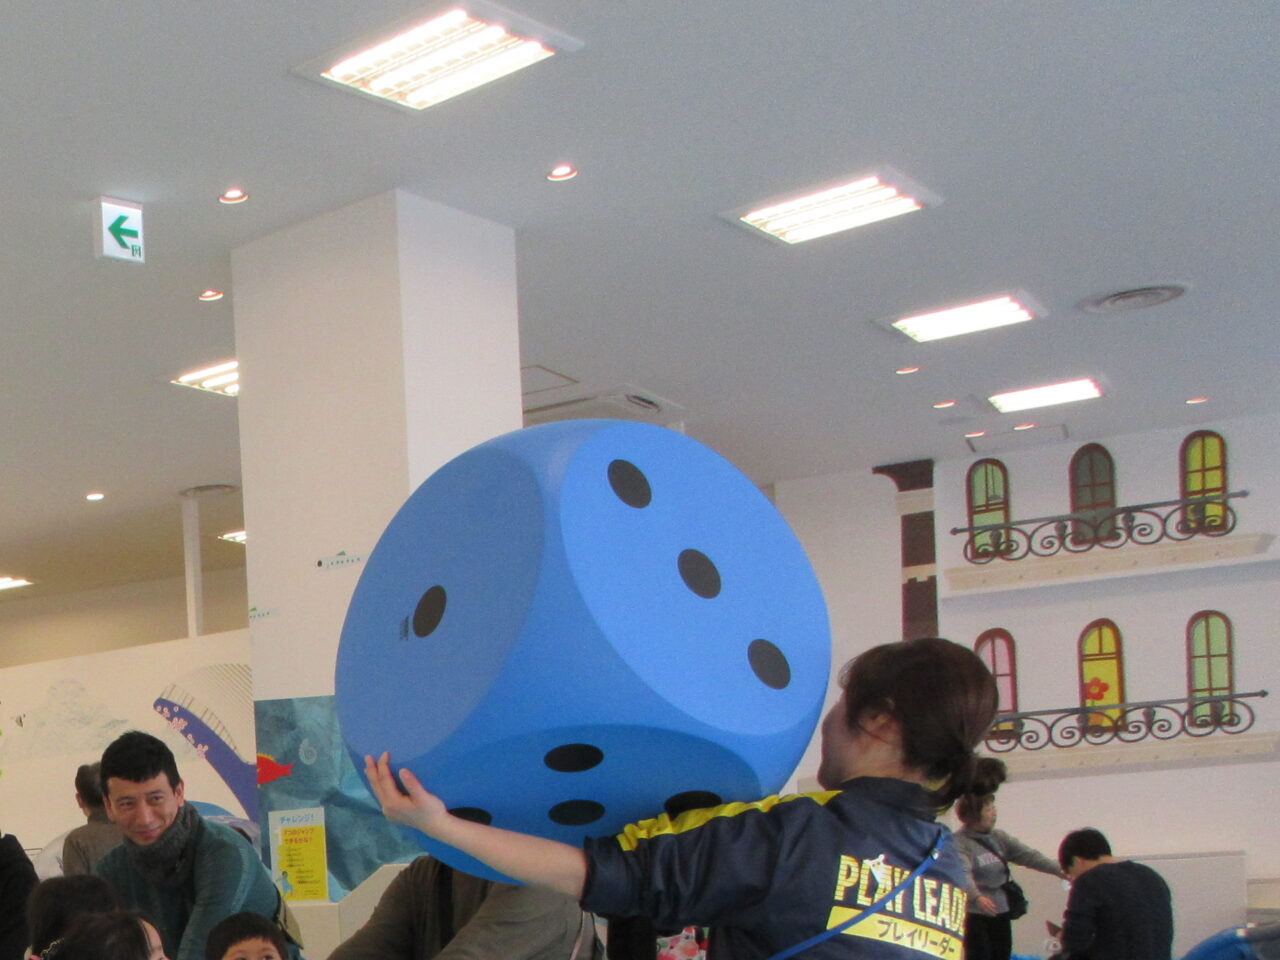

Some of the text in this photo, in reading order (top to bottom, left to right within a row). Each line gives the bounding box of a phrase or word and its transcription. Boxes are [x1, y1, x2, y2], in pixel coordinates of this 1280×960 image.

[834, 855, 968, 938] PLAY LEAD
[877, 918, 955, 956] プレイリーダー
